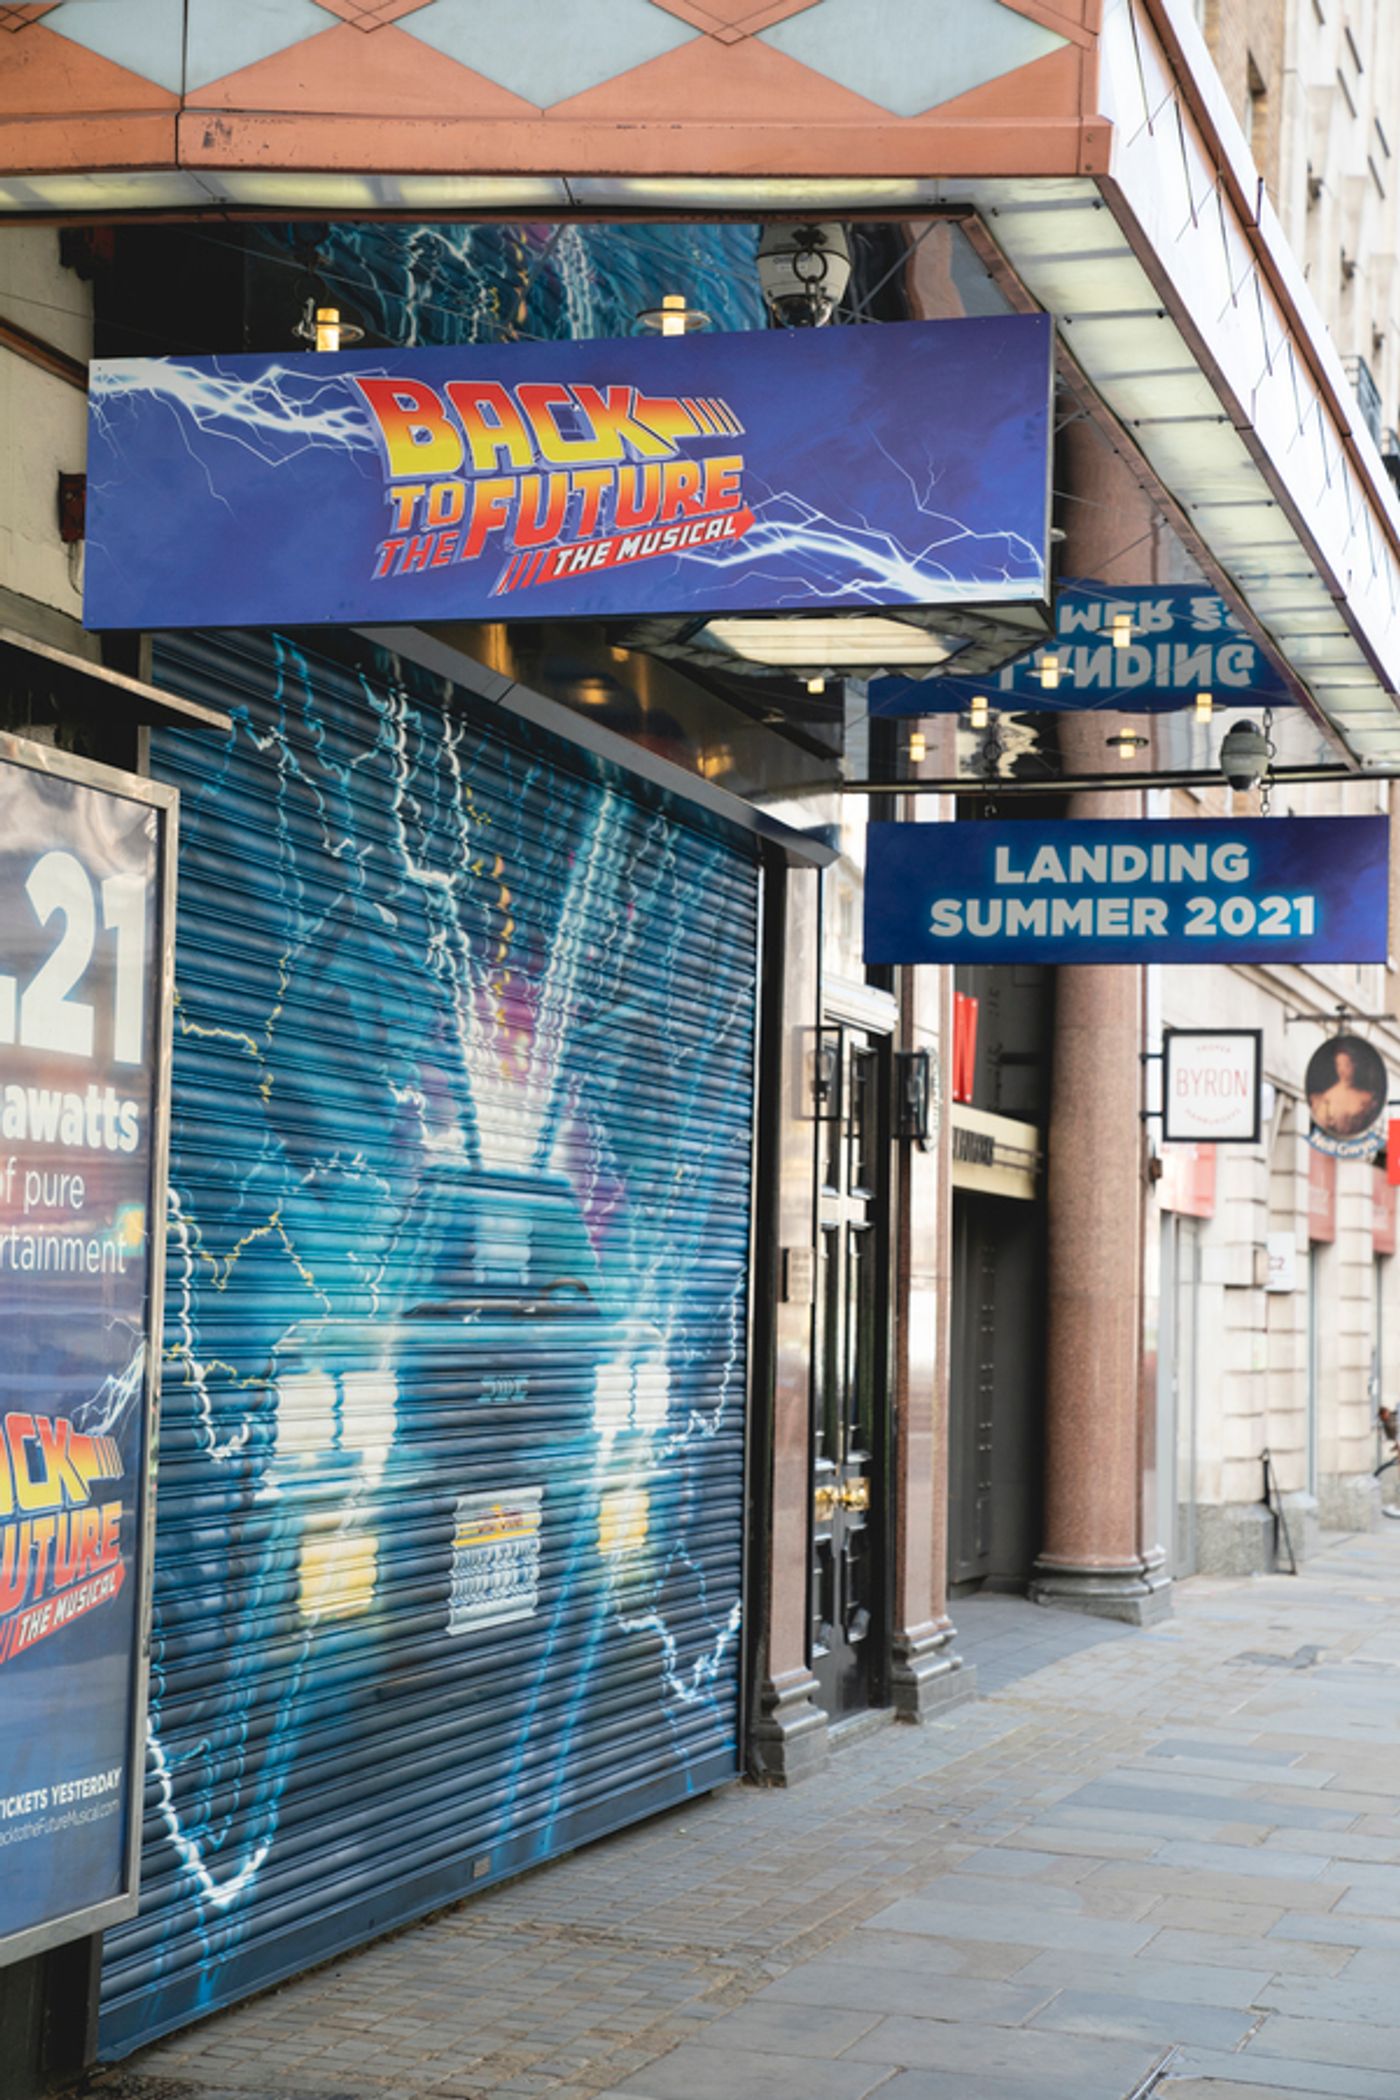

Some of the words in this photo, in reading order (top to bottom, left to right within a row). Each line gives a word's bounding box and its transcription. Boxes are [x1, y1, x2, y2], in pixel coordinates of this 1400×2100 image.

[354, 376, 690, 477] BACK
[374, 531, 460, 578] THE
[462, 456, 744, 560] FUTURE
[390, 481, 466, 532] TO
[552, 543, 609, 576] THE
[615, 515, 737, 562] MUSICAL
[994, 843, 1250, 885] LANDING
[928, 897, 1169, 938] SUMMER
[1183, 895, 1316, 937] 2021
[1175, 1067, 1249, 1098] BYRON
[0, 1083, 140, 1152] awatts
[23, 1169, 86, 1215] pure
[17, 1604, 52, 1647] THE
[52, 1570, 117, 1627] MUSICAL
[50, 1766, 122, 1806] YESTERDAY
